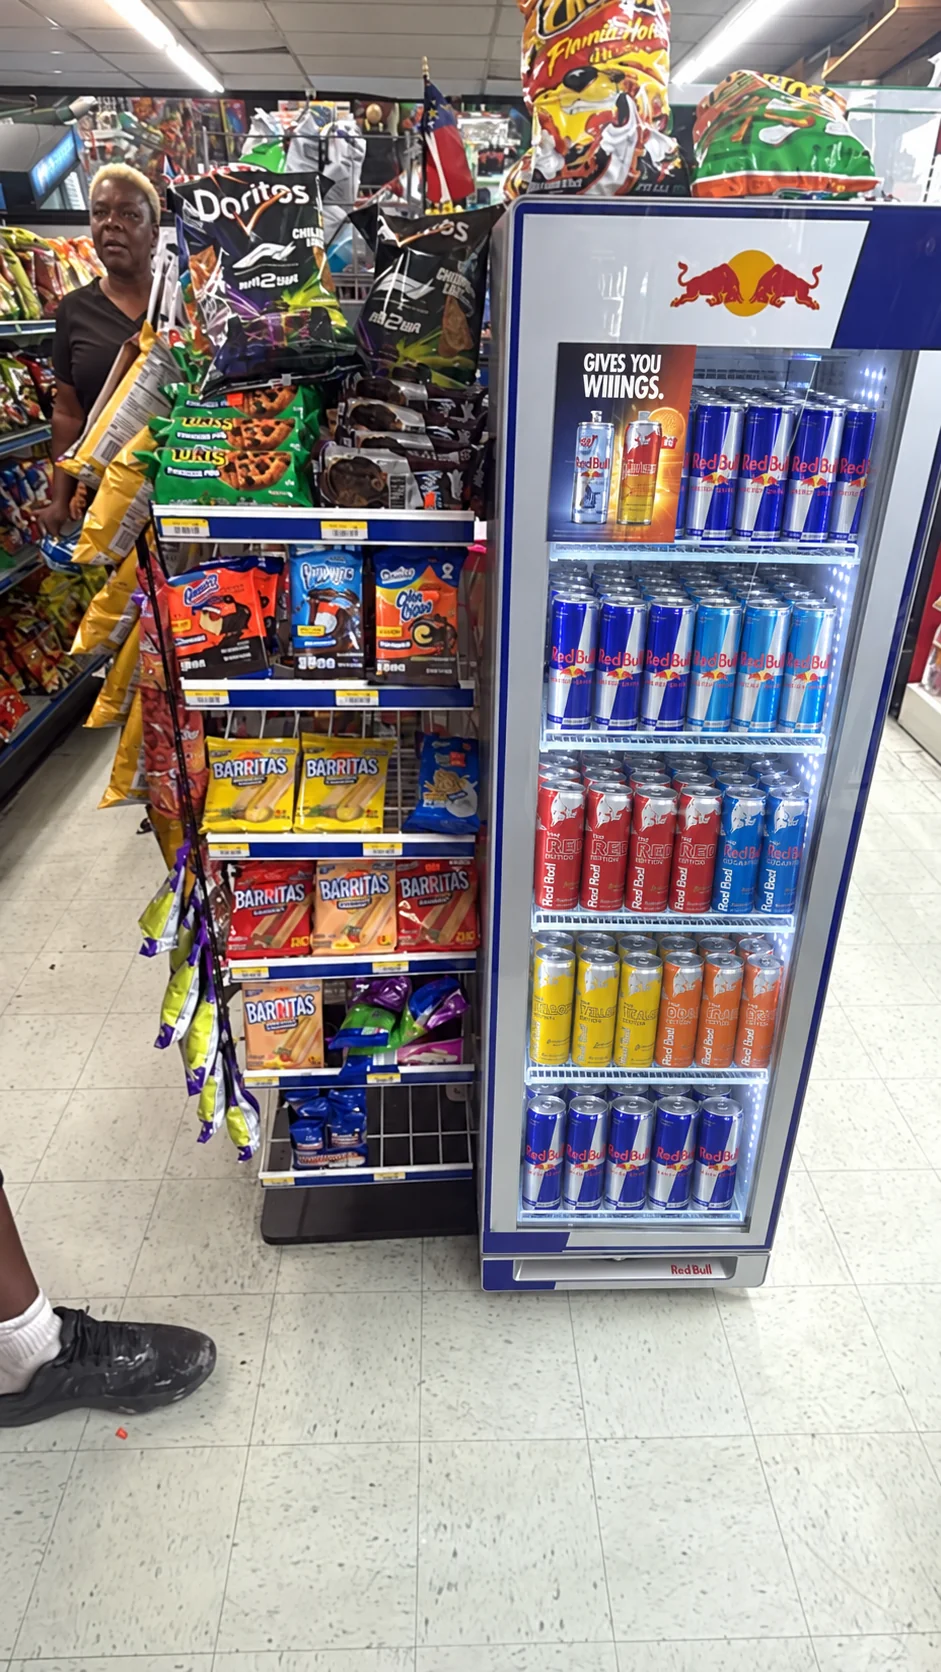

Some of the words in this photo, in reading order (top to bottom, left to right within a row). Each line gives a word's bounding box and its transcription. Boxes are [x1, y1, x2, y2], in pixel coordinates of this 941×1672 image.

[193, 180, 310, 223] Doritos
[583, 353, 626, 373] GIVES
[630, 354, 662, 374] YOU
[583, 374, 664, 400] WIIINGS.
[213, 758, 287, 778] BARRITAS
[306, 758, 378, 778] BARRITAS
[234, 884, 305, 909] BARRITAS
[321, 874, 389, 900] BARRITAS
[400, 871, 469, 898] BARRITAS
[671, 1264, 691, 1275] Red
[692, 1263, 712, 1275] Bull
